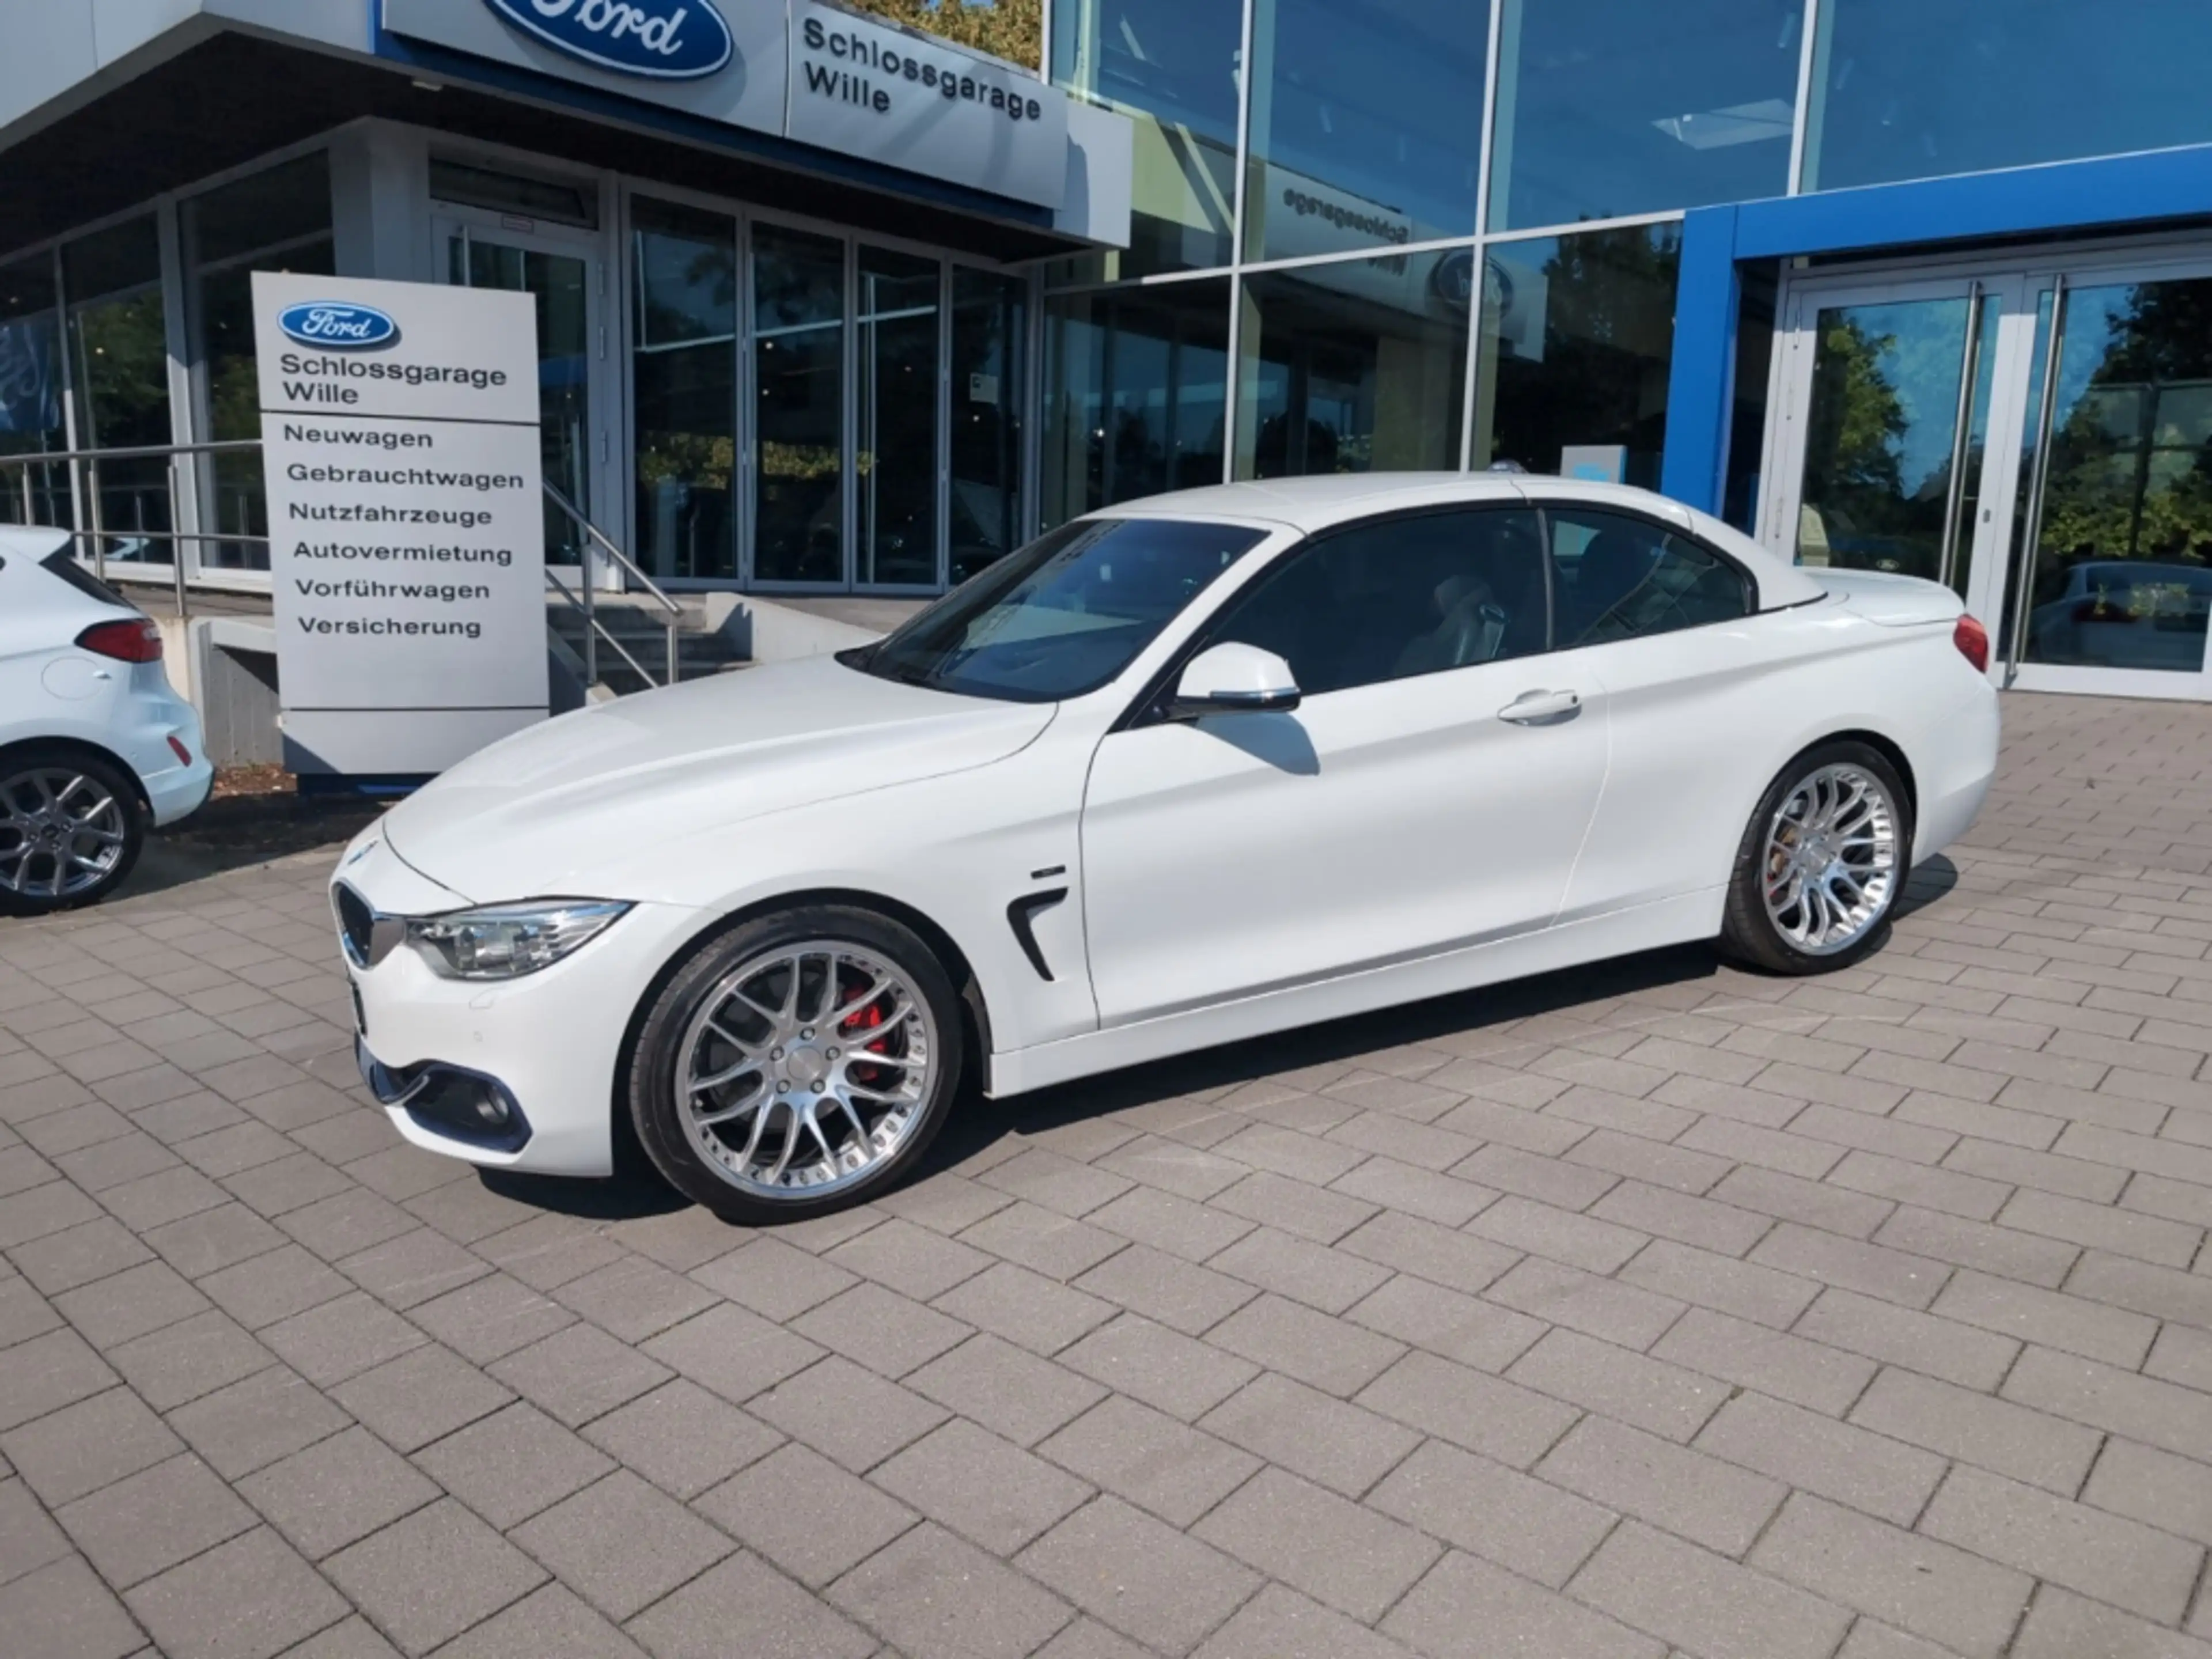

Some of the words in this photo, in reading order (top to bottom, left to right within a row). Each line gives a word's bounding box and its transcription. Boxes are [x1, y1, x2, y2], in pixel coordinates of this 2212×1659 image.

[804, 17, 1041, 120] Schlossgarage
[804, 60, 891, 112] Wille
[301, 308, 372, 338] Ford
[280, 354, 507, 389] Schlossgarage
[282, 381, 358, 404] Wille
[284, 424, 433, 450] Neuwagen
[287, 463, 524, 491] Gebrauchtwagen
[289, 502, 493, 528] Nutzfahrzeuge
[293, 541, 513, 566] Autovermietung
[295, 578, 490, 603] Vorführwagen
[298, 616, 482, 639] Versicherung
